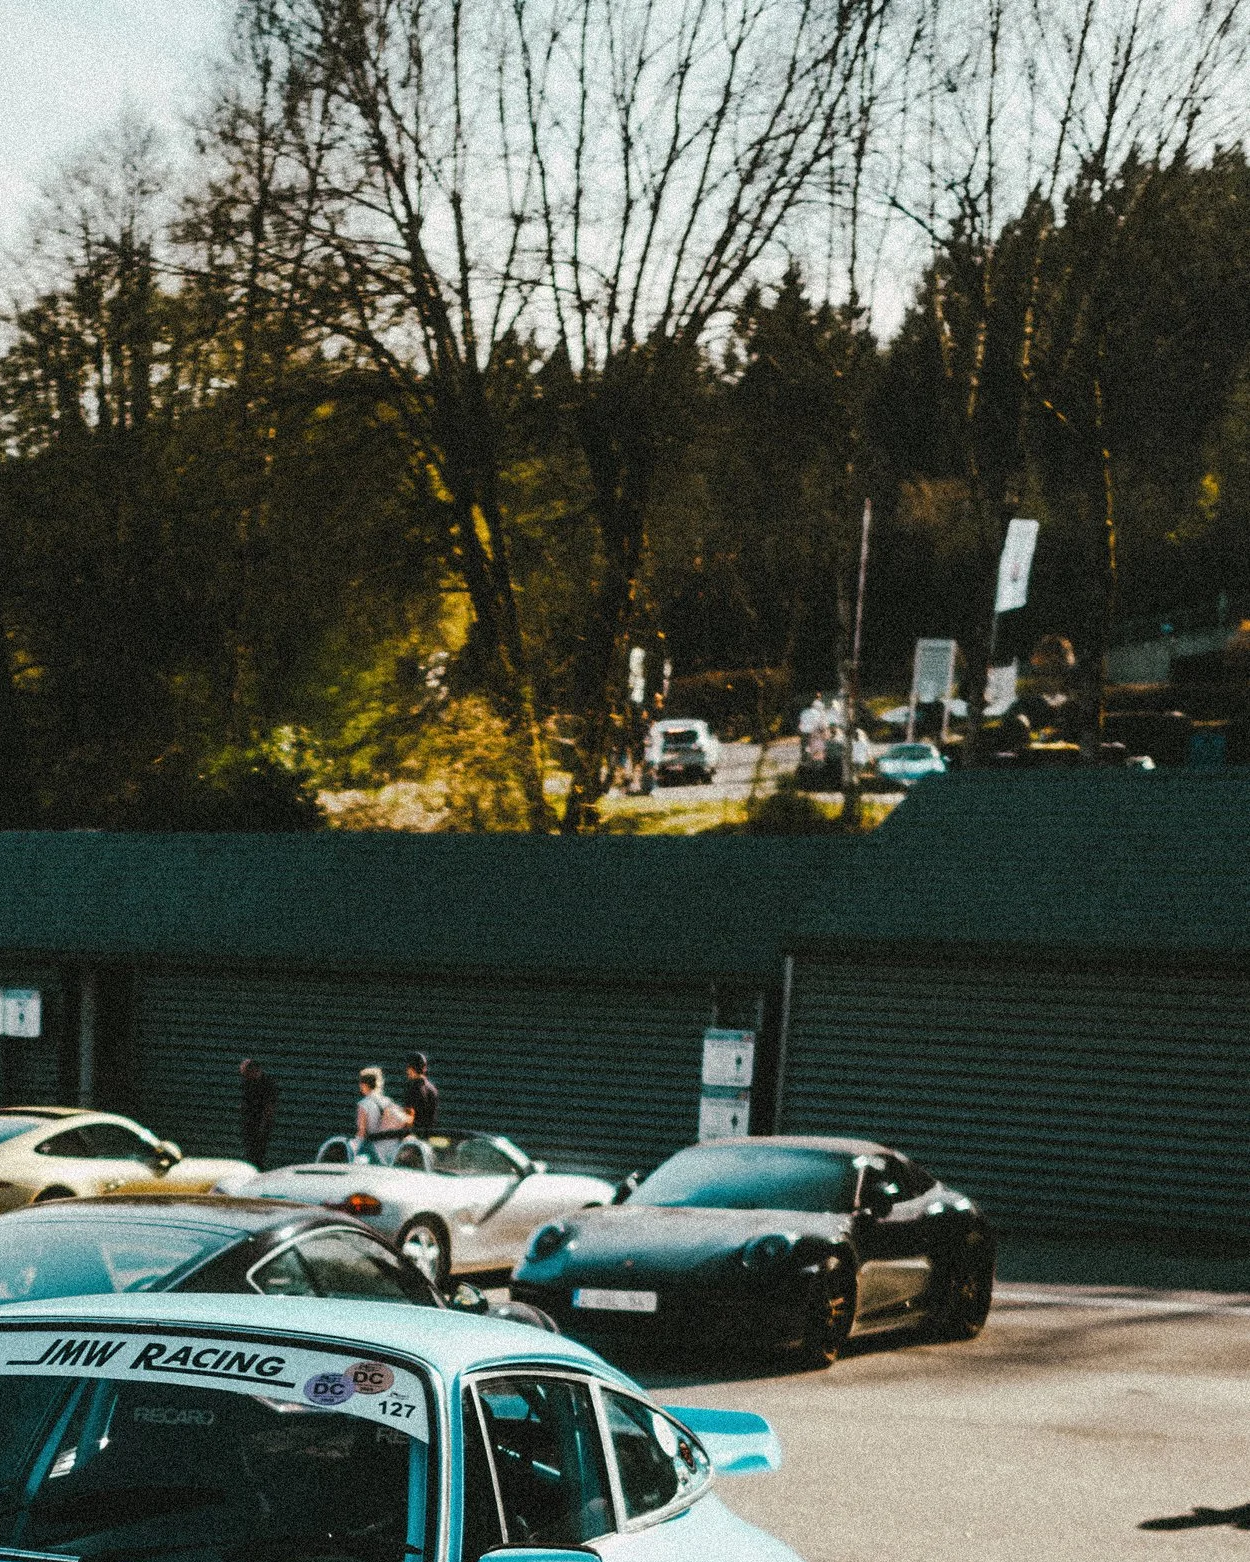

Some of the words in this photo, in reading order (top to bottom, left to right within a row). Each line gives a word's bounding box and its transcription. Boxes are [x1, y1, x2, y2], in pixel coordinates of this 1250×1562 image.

[6, 1338, 127, 1368] JMW
[129, 1342, 293, 1384] RACING
[352, 1370, 385, 1385] DC
[313, 1382, 346, 1396] DC
[132, 1406, 216, 1426] RECARO
[378, 1400, 417, 1419] 127
